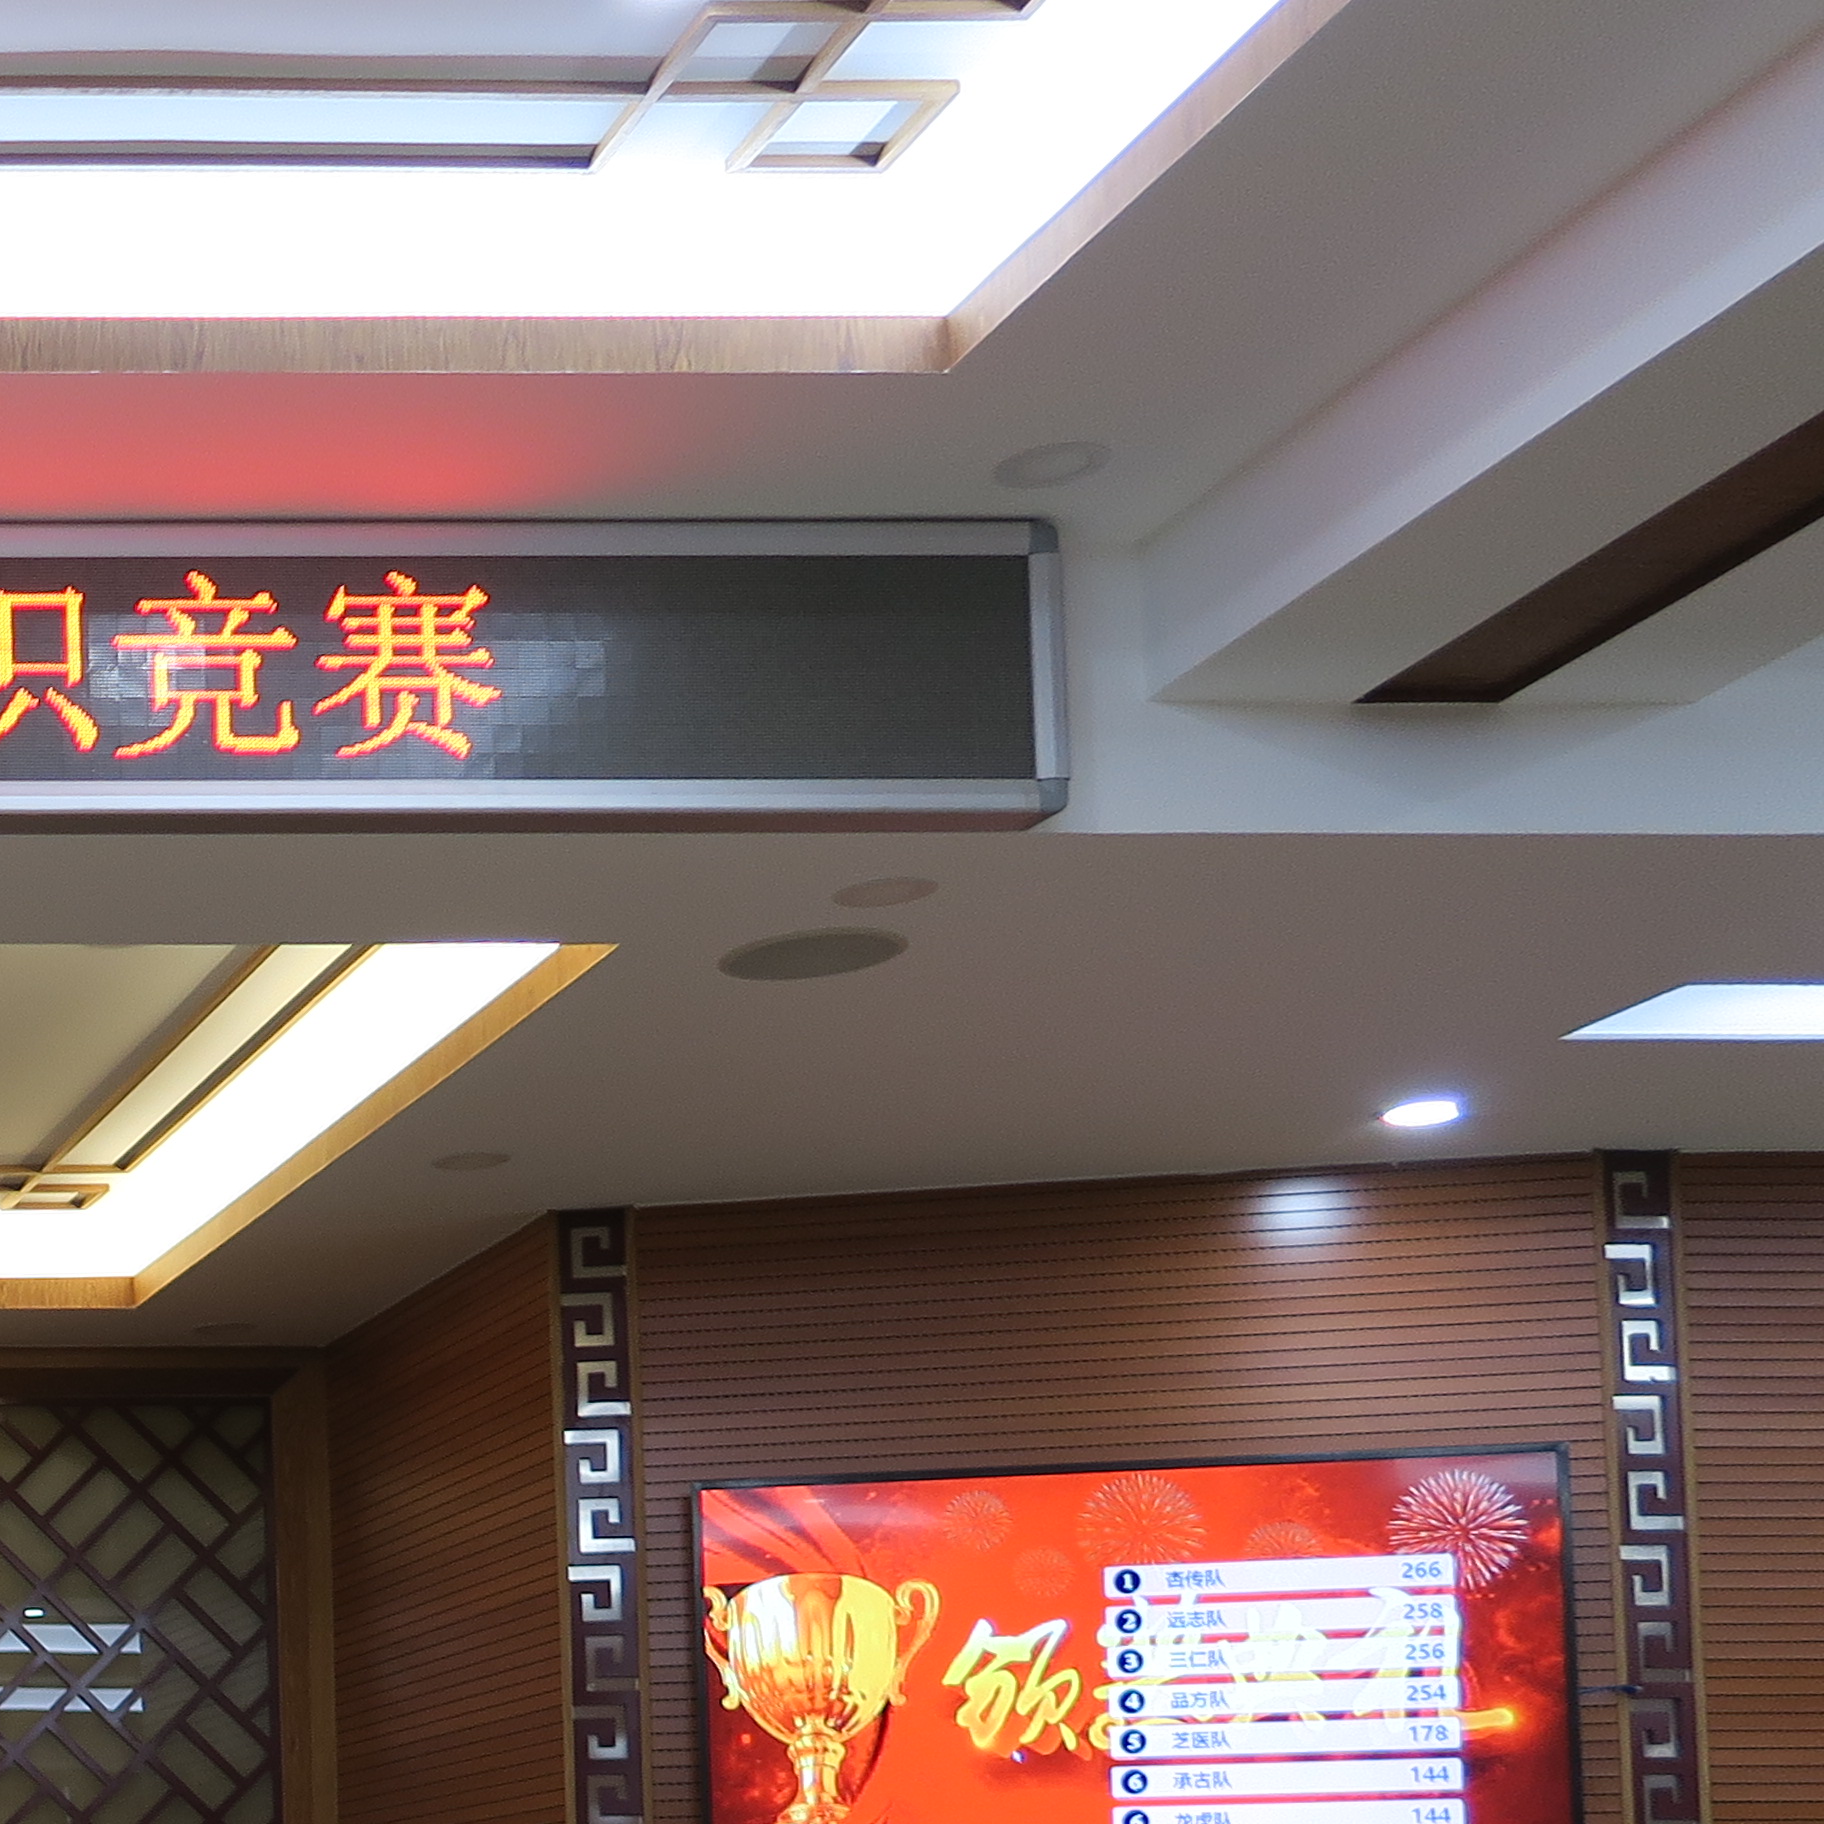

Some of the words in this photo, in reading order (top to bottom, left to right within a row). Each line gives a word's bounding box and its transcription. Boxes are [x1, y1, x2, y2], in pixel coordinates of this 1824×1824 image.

[1401, 1561, 1442, 1579] 266
[1166, 1610, 1227, 1630] 远志队
[1403, 1602, 1444, 1620] 258
[1169, 1650, 1229, 1670] 三仁队
[1405, 1643, 1446, 1660] 256
[1170, 1690, 1230, 1710] 品方队
[1406, 1684, 1447, 1702] 254
[1171, 1731, 1232, 1750] 芝医队
[1408, 1724, 1449, 1742] 178
[1410, 1765, 1450, 1783] 144
[1411, 1807, 1452, 1824] 144
